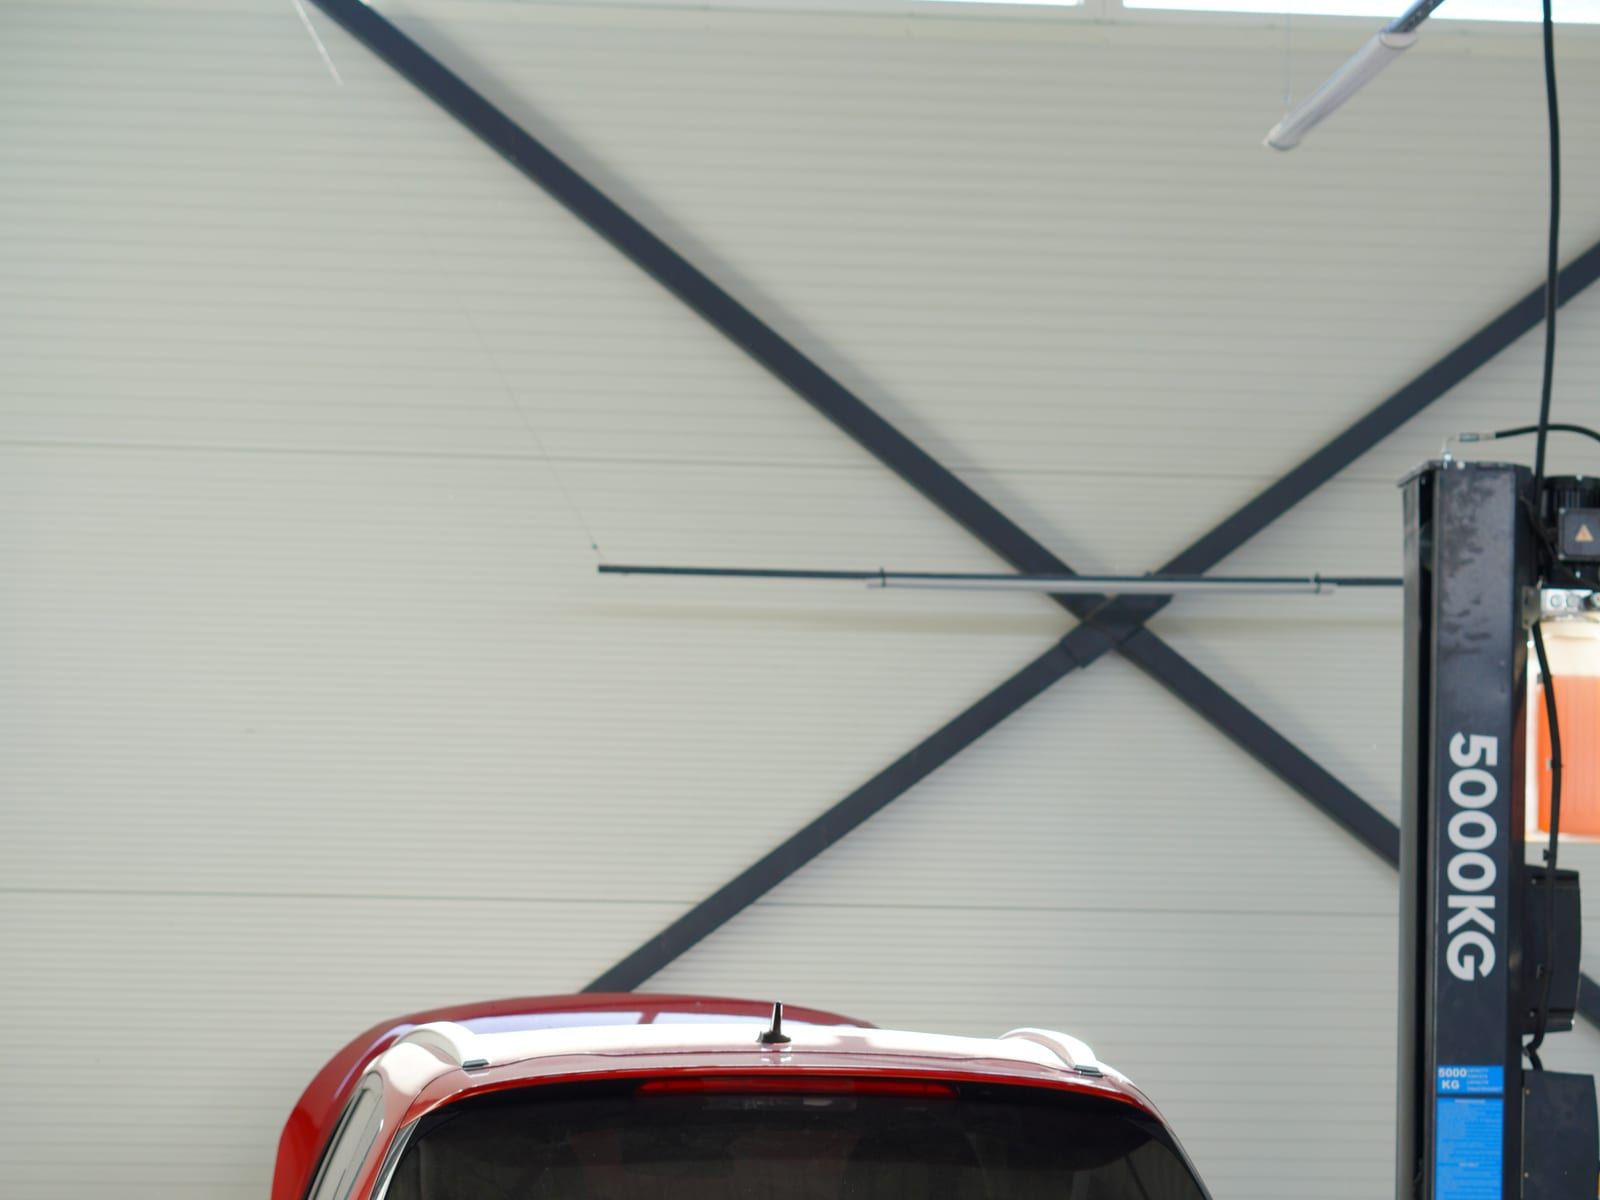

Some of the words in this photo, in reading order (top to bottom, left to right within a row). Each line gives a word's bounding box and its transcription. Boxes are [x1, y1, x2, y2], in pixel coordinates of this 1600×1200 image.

[1446, 731, 1498, 981] 5000KG
[1438, 1067, 1467, 1078] 5000
[1442, 1079, 1460, 1090] KG
